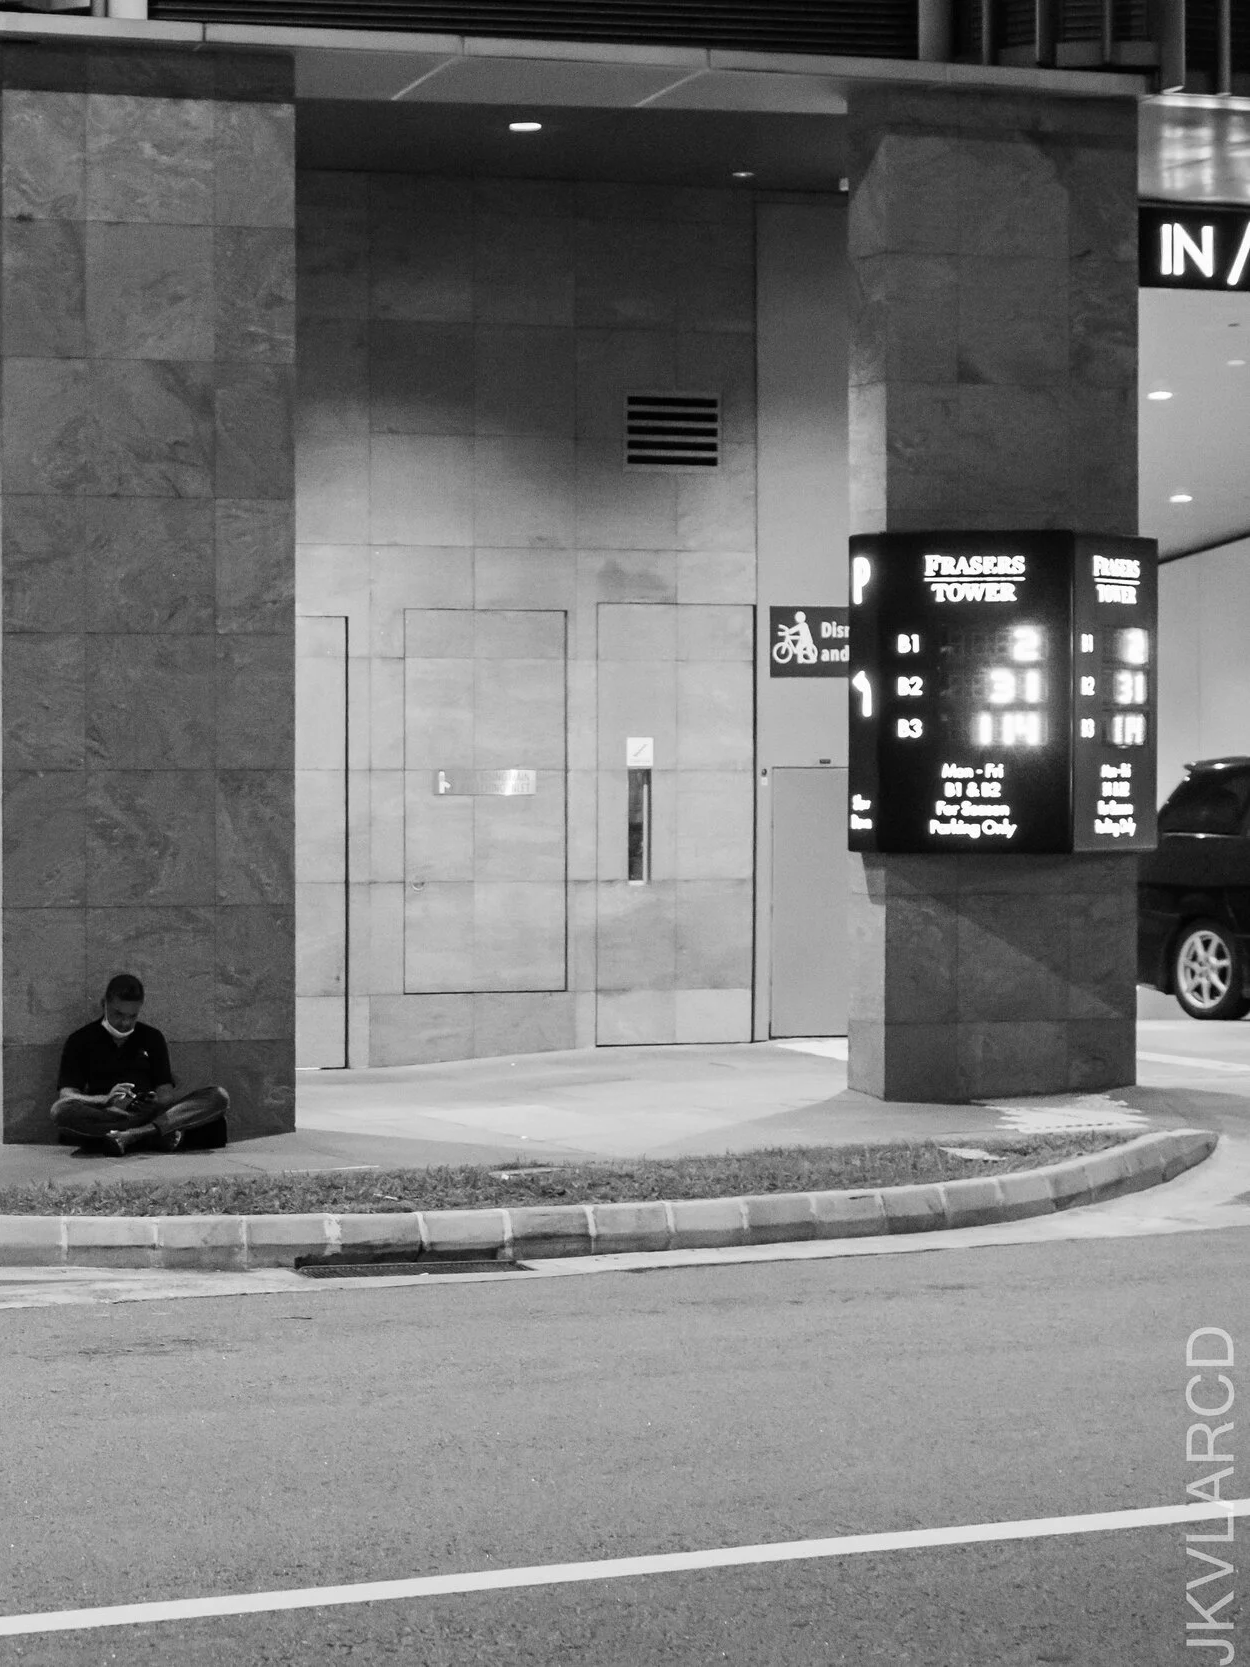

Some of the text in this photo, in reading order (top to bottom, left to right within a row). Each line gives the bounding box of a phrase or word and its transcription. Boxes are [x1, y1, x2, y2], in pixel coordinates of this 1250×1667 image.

[924, 555, 1025, 576] FRASERS
[931, 583, 1017, 602] TOWER
[898, 634, 919, 653] B1
[1014, 629, 1038, 660] 2
[821, 645, 850, 662] and
[898, 676, 923, 696] B2
[991, 671, 1039, 702] 31
[898, 718, 922, 738] B3
[941, 763, 974, 778] Mon
[985, 763, 1004, 778] Fri
[945, 782, 1001, 797] B1 & B2
[936, 801, 1010, 816] For Season
[930, 818, 1017, 838] Parking Only
